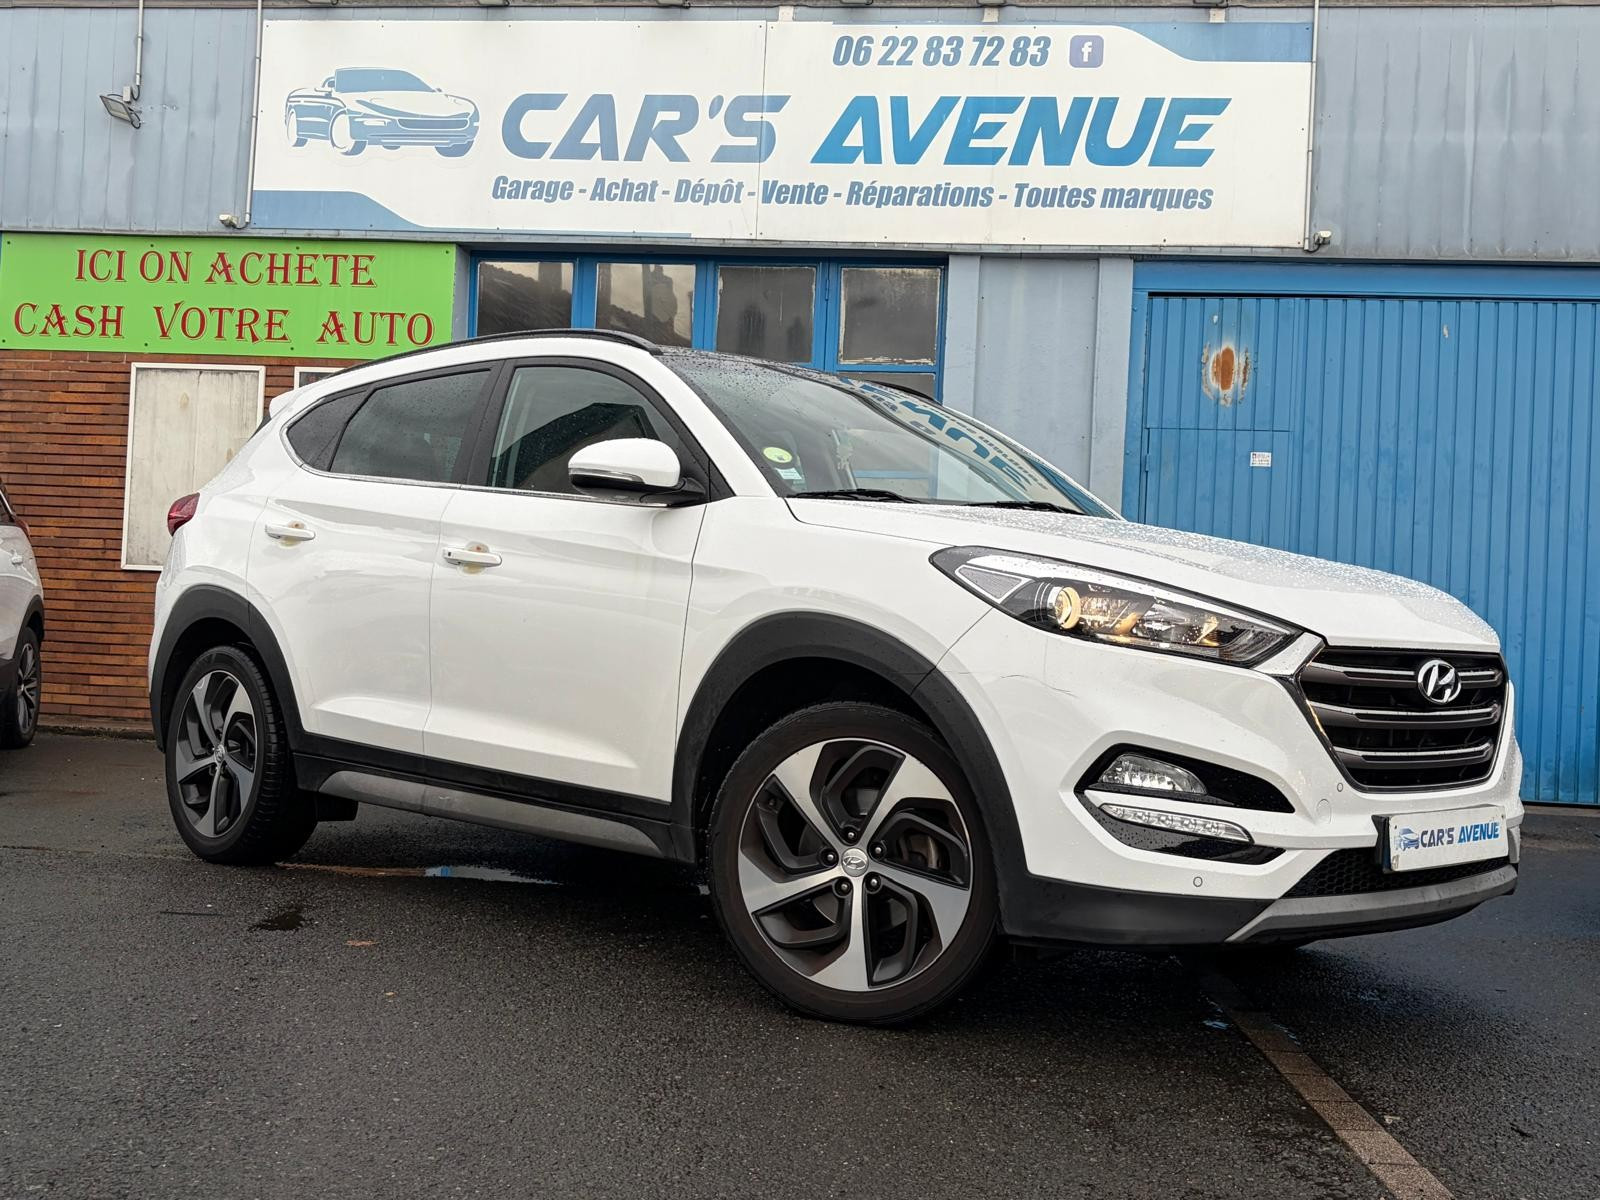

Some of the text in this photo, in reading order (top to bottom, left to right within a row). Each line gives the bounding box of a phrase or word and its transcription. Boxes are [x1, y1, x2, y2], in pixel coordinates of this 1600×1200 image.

[832, 35, 1051, 66] 06 22 83 72 83
[502, 93, 1232, 167] CAR'S AVENUE
[492, 175, 574, 203] Garage
[589, 177, 658, 203] Achat
[674, 178, 744, 206] Dépôt
[760, 179, 829, 206] Vente
[846, 180, 995, 209] Réparations
[1013, 182, 1097, 209] Toutes
[1099, 186, 1214, 212] marques
[75, 249, 377, 288] ICI ON ACHETE
[14, 300, 434, 346] CASH VOTRE AUTO
[1420, 821, 1500, 848] CAR'S AVENUE
